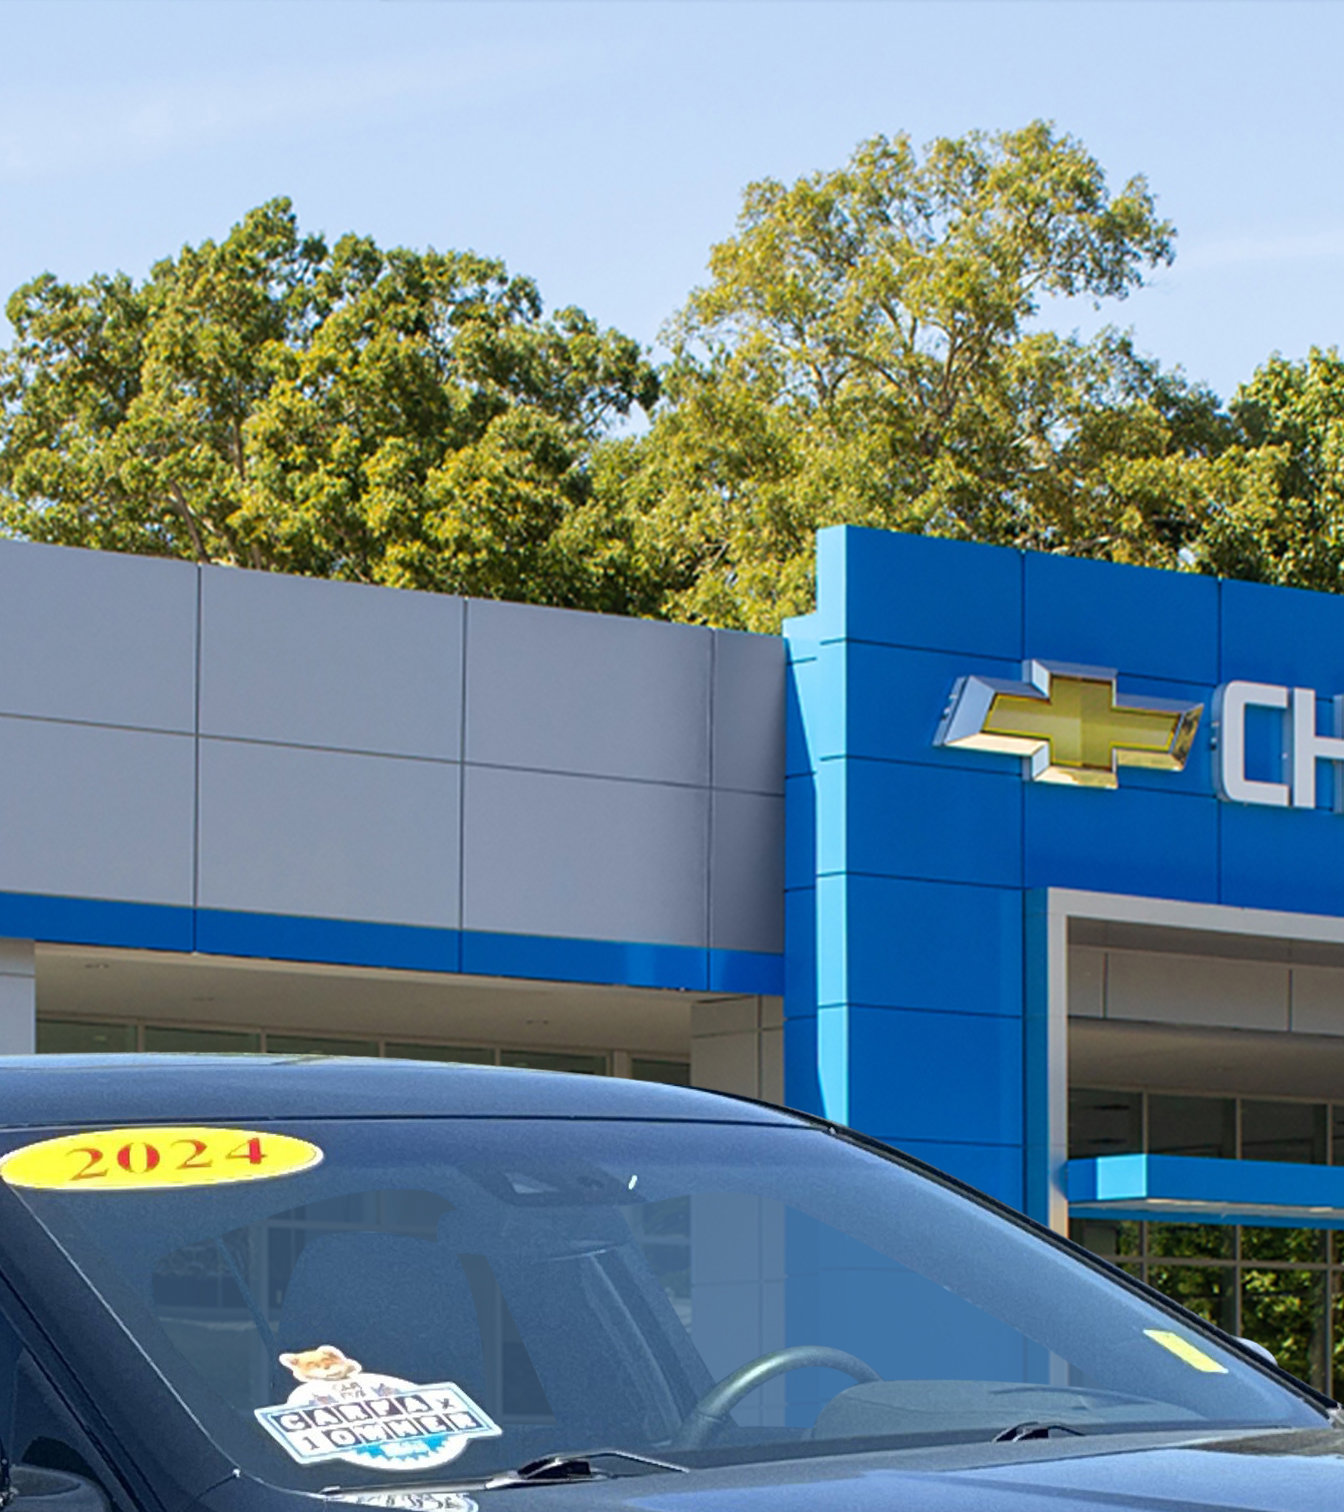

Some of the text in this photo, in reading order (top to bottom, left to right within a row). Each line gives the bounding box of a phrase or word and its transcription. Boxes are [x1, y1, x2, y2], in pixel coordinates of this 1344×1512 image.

[65, 1137, 268, 1181] 2024
[276, 1394, 456, 1432] CARFAX
[324, 1411, 486, 1448] OWNER
